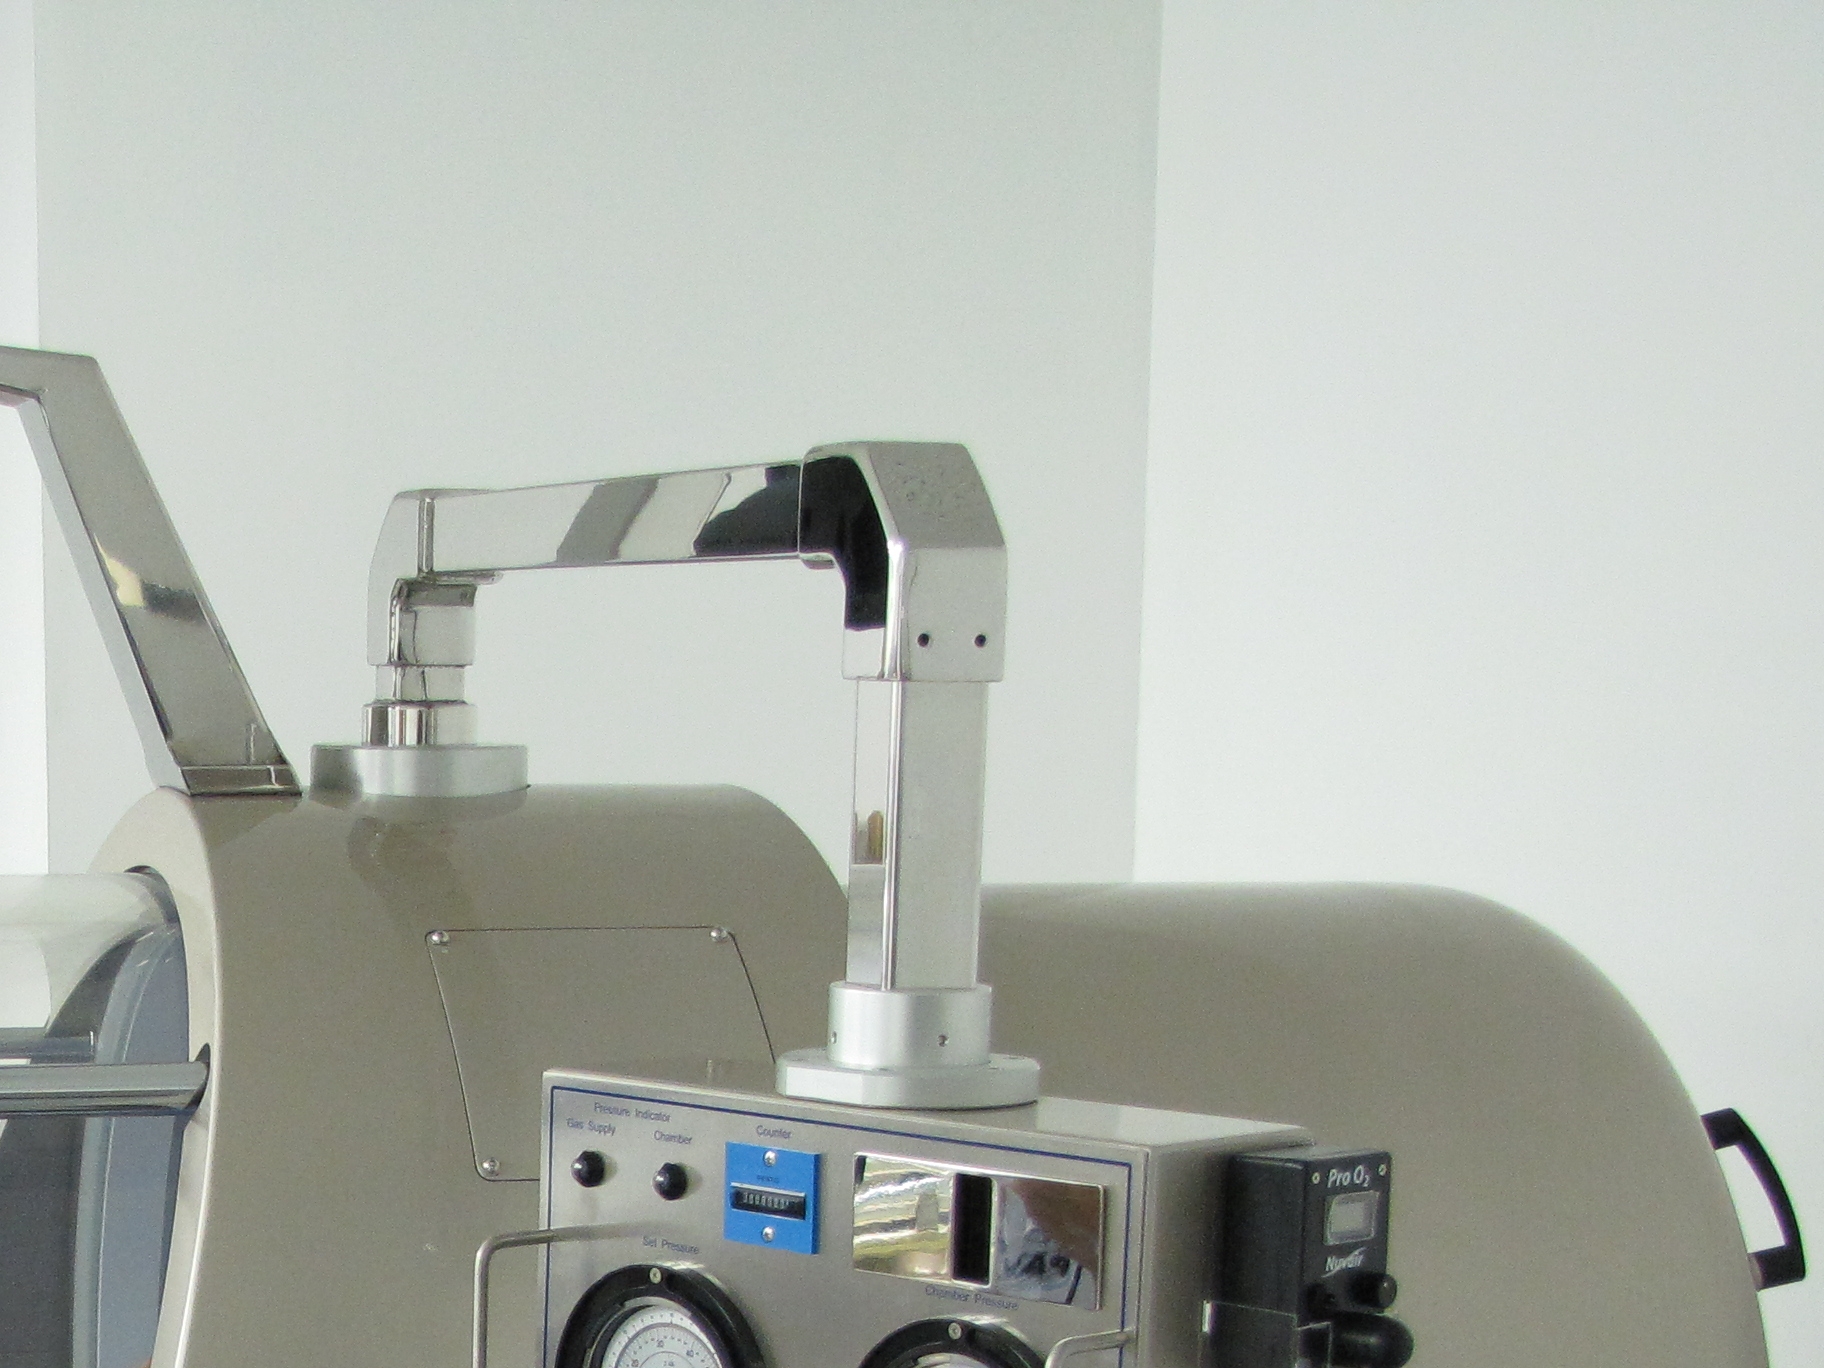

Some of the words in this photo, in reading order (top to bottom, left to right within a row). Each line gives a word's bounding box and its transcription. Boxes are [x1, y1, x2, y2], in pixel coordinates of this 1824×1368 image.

[594, 1101, 631, 1118] Pressure
[635, 1106, 671, 1123] Indicator
[566, 1118, 585, 1130] Gas
[588, 1119, 617, 1137] Supply
[756, 1124, 792, 1140] Counter
[653, 1129, 693, 1146] Chamber
[1327, 1168, 1351, 1188] Pro
[661, 1238, 700, 1255] Pressure
[925, 1285, 971, 1303] Chamber
[974, 1293, 1019, 1311] Pressure
